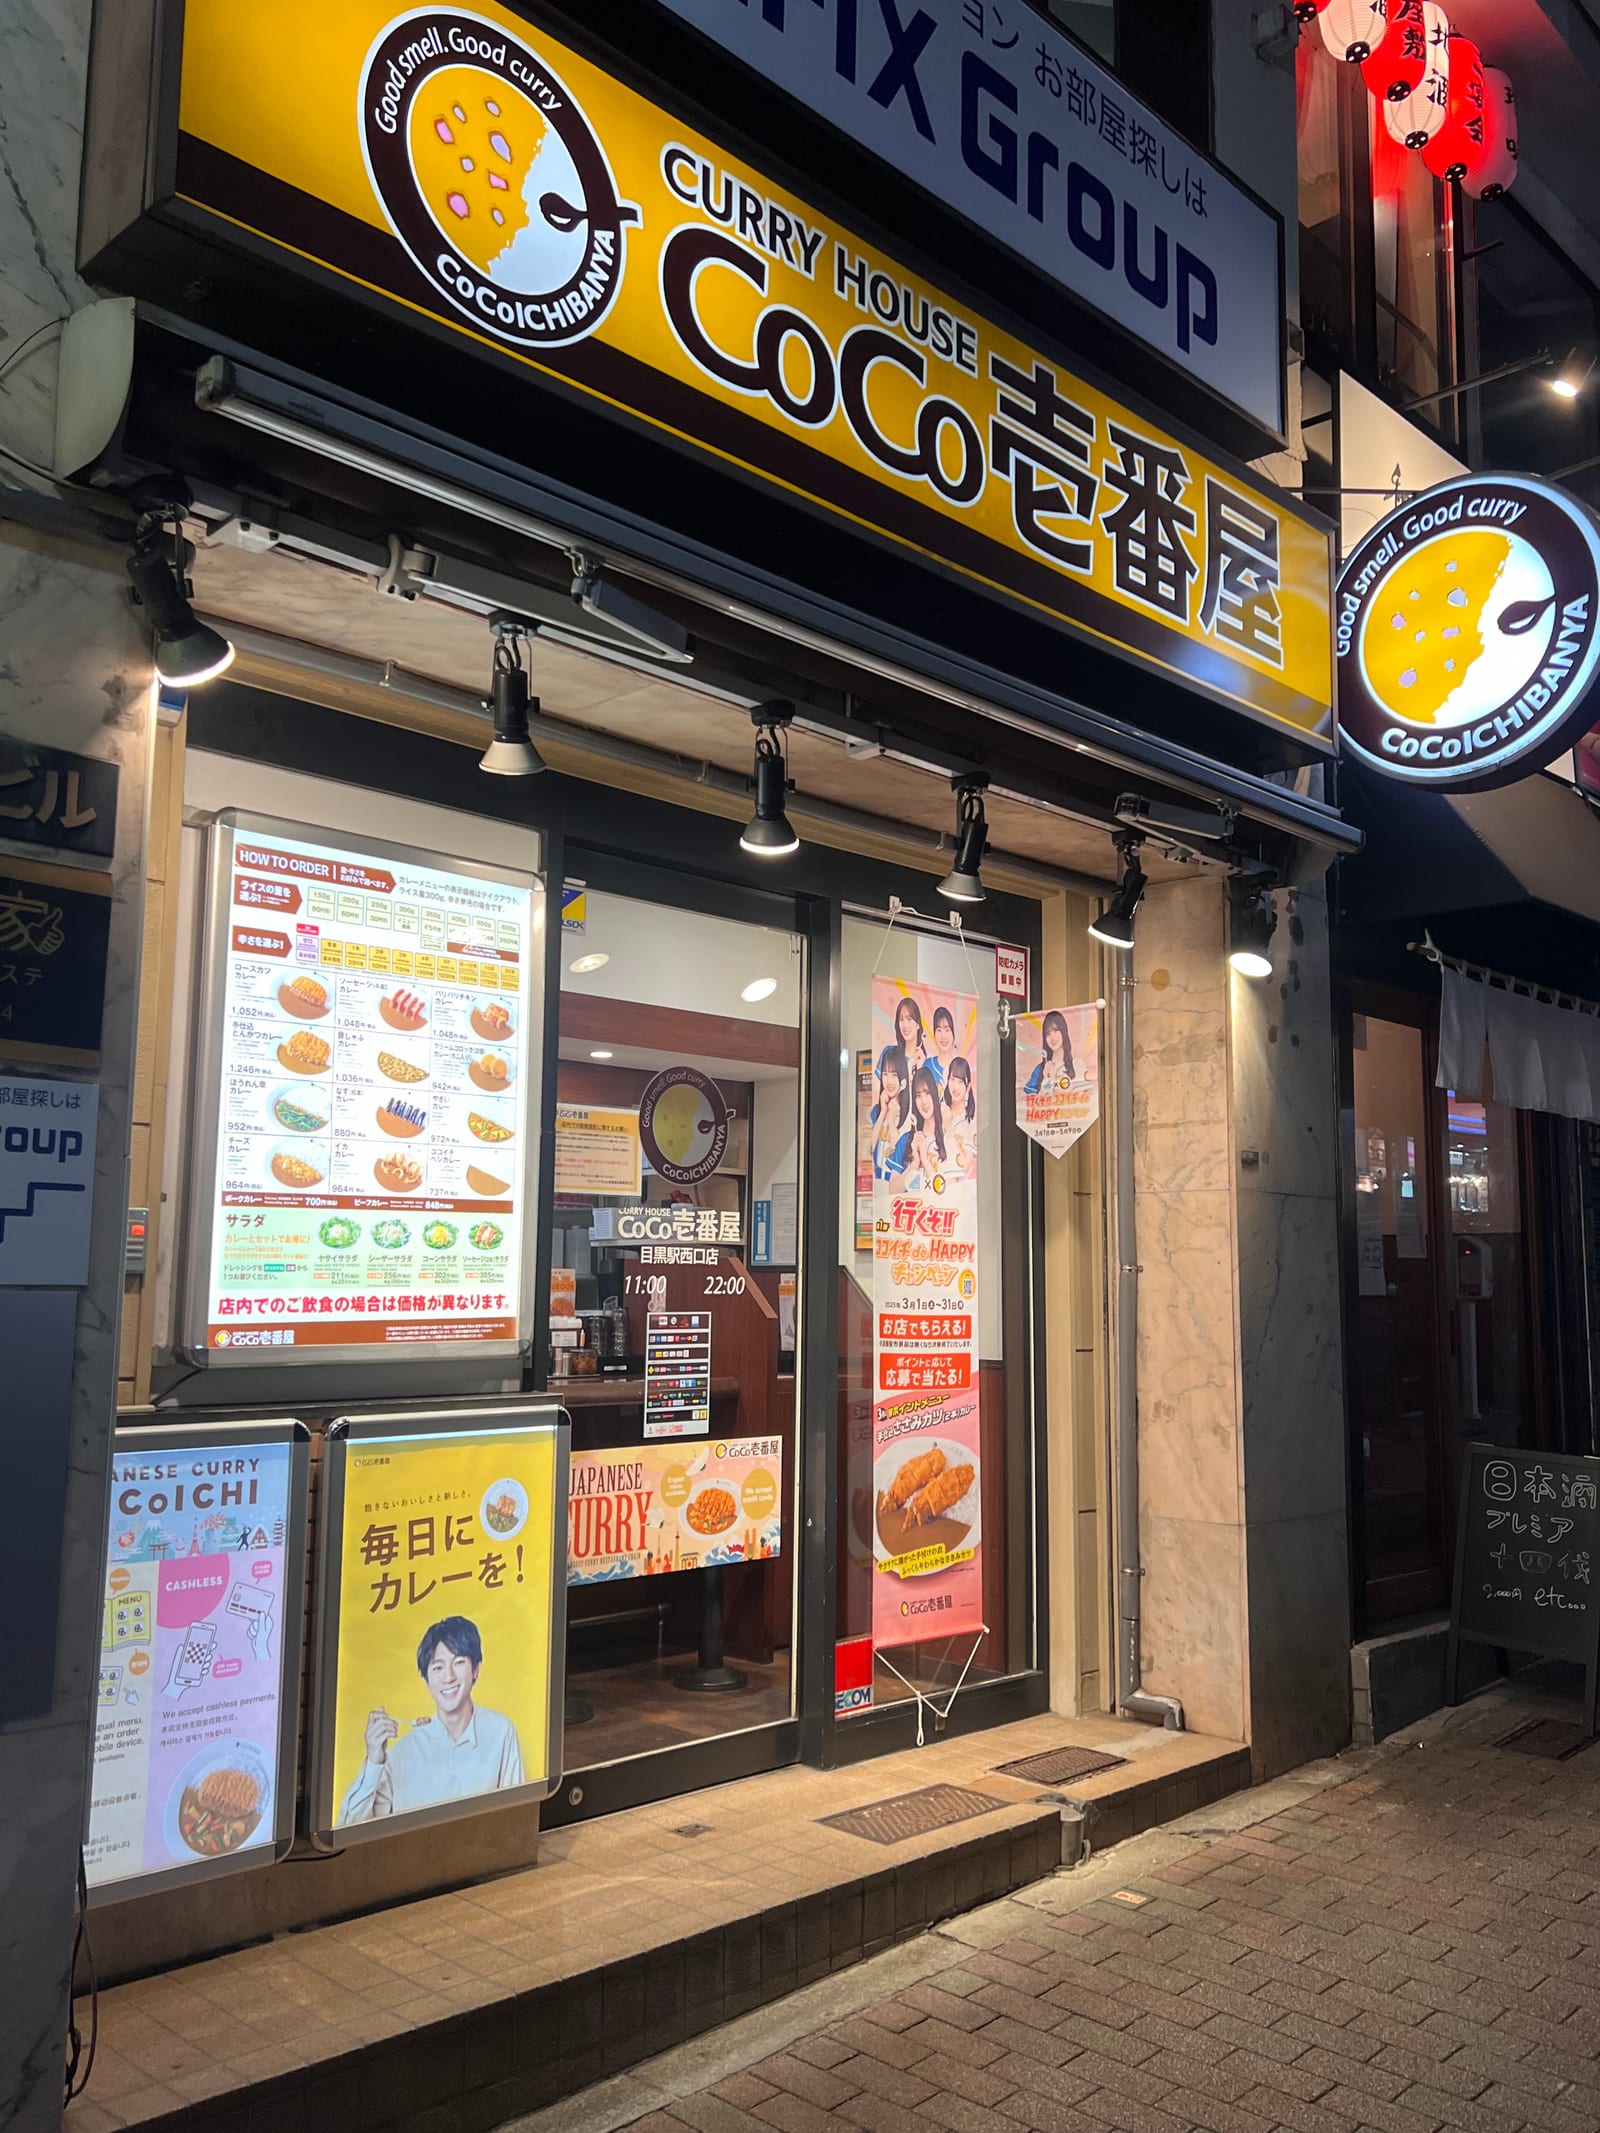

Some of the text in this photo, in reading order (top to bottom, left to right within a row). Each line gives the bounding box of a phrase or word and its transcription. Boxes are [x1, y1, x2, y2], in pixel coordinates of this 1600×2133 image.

[374, 27, 563, 134] Good smell. Good curry
[1034, 42, 1209, 220] お部屋探しは
[960, 49, 1218, 355] Group
[661, 141, 980, 373] CURRY HOUSE
[435, 228, 616, 332] CoCoICHIBANYA
[658, 223, 1286, 671] CoCo壱番屋
[1336, 495, 1528, 657] Good smell. Good curry
[1381, 593, 1590, 760] CoCoICHIBANYA
[240, 850, 330, 877] HOW TO ORDER
[398, 905, 416, 915] 300g
[235, 963, 271, 975] ロースカツ
[232, 1030, 283, 1040] とんかつカレー
[0, 1087, 81, 1109] 部屋探しは
[335, 1095, 355, 1103] カレー
[642, 1100, 653, 1128] Good
[666, 1071, 686, 1084] Good
[687, 1073, 706, 1088] curry
[1026, 1108, 1059, 1121] HAPPY
[227, 1145, 250, 1153] カレー
[228, 1137, 250, 1145] チーズ
[662, 1123, 727, 1181] CoCoICHIBANYA
[226, 1214, 266, 1227] サラダ
[618, 1207, 671, 1217] CURRY HOUSE
[618, 1208, 741, 1242] CoCo壱番屋
[640, 1246, 719, 1265] 目黒駅西口店
[929, 1238, 975, 1260] HAPPY
[624, 1275, 746, 1295] 11:00 22:00
[218, 1294, 509, 1315] 店内でのご飲食の場合は価格が異なります。
[882, 1318, 966, 1336] お店でもらえる!
[896, 1357, 953, 1368] ポイントに応じて
[885, 1369, 962, 1387] 応募で当たる!
[729, 1440, 779, 1458] CoCo壱番屋
[191, 1458, 260, 1476] CURRY
[569, 1463, 643, 1496] JAPANESE
[118, 1479, 259, 1515] CoICHI
[1486, 1509, 1574, 1543] プレミア
[359, 1514, 475, 1566] 毎日に
[166, 1576, 223, 1592] CASHLESS
[368, 1545, 525, 1614] カレーを!
[118, 1595, 142, 1606] MENU
[162, 1693, 276, 1719] We accept cashless payments.
[118, 1717, 144, 1728] menu.
[116, 1737, 144, 1749] device.
[117, 1728, 140, 1739] order
